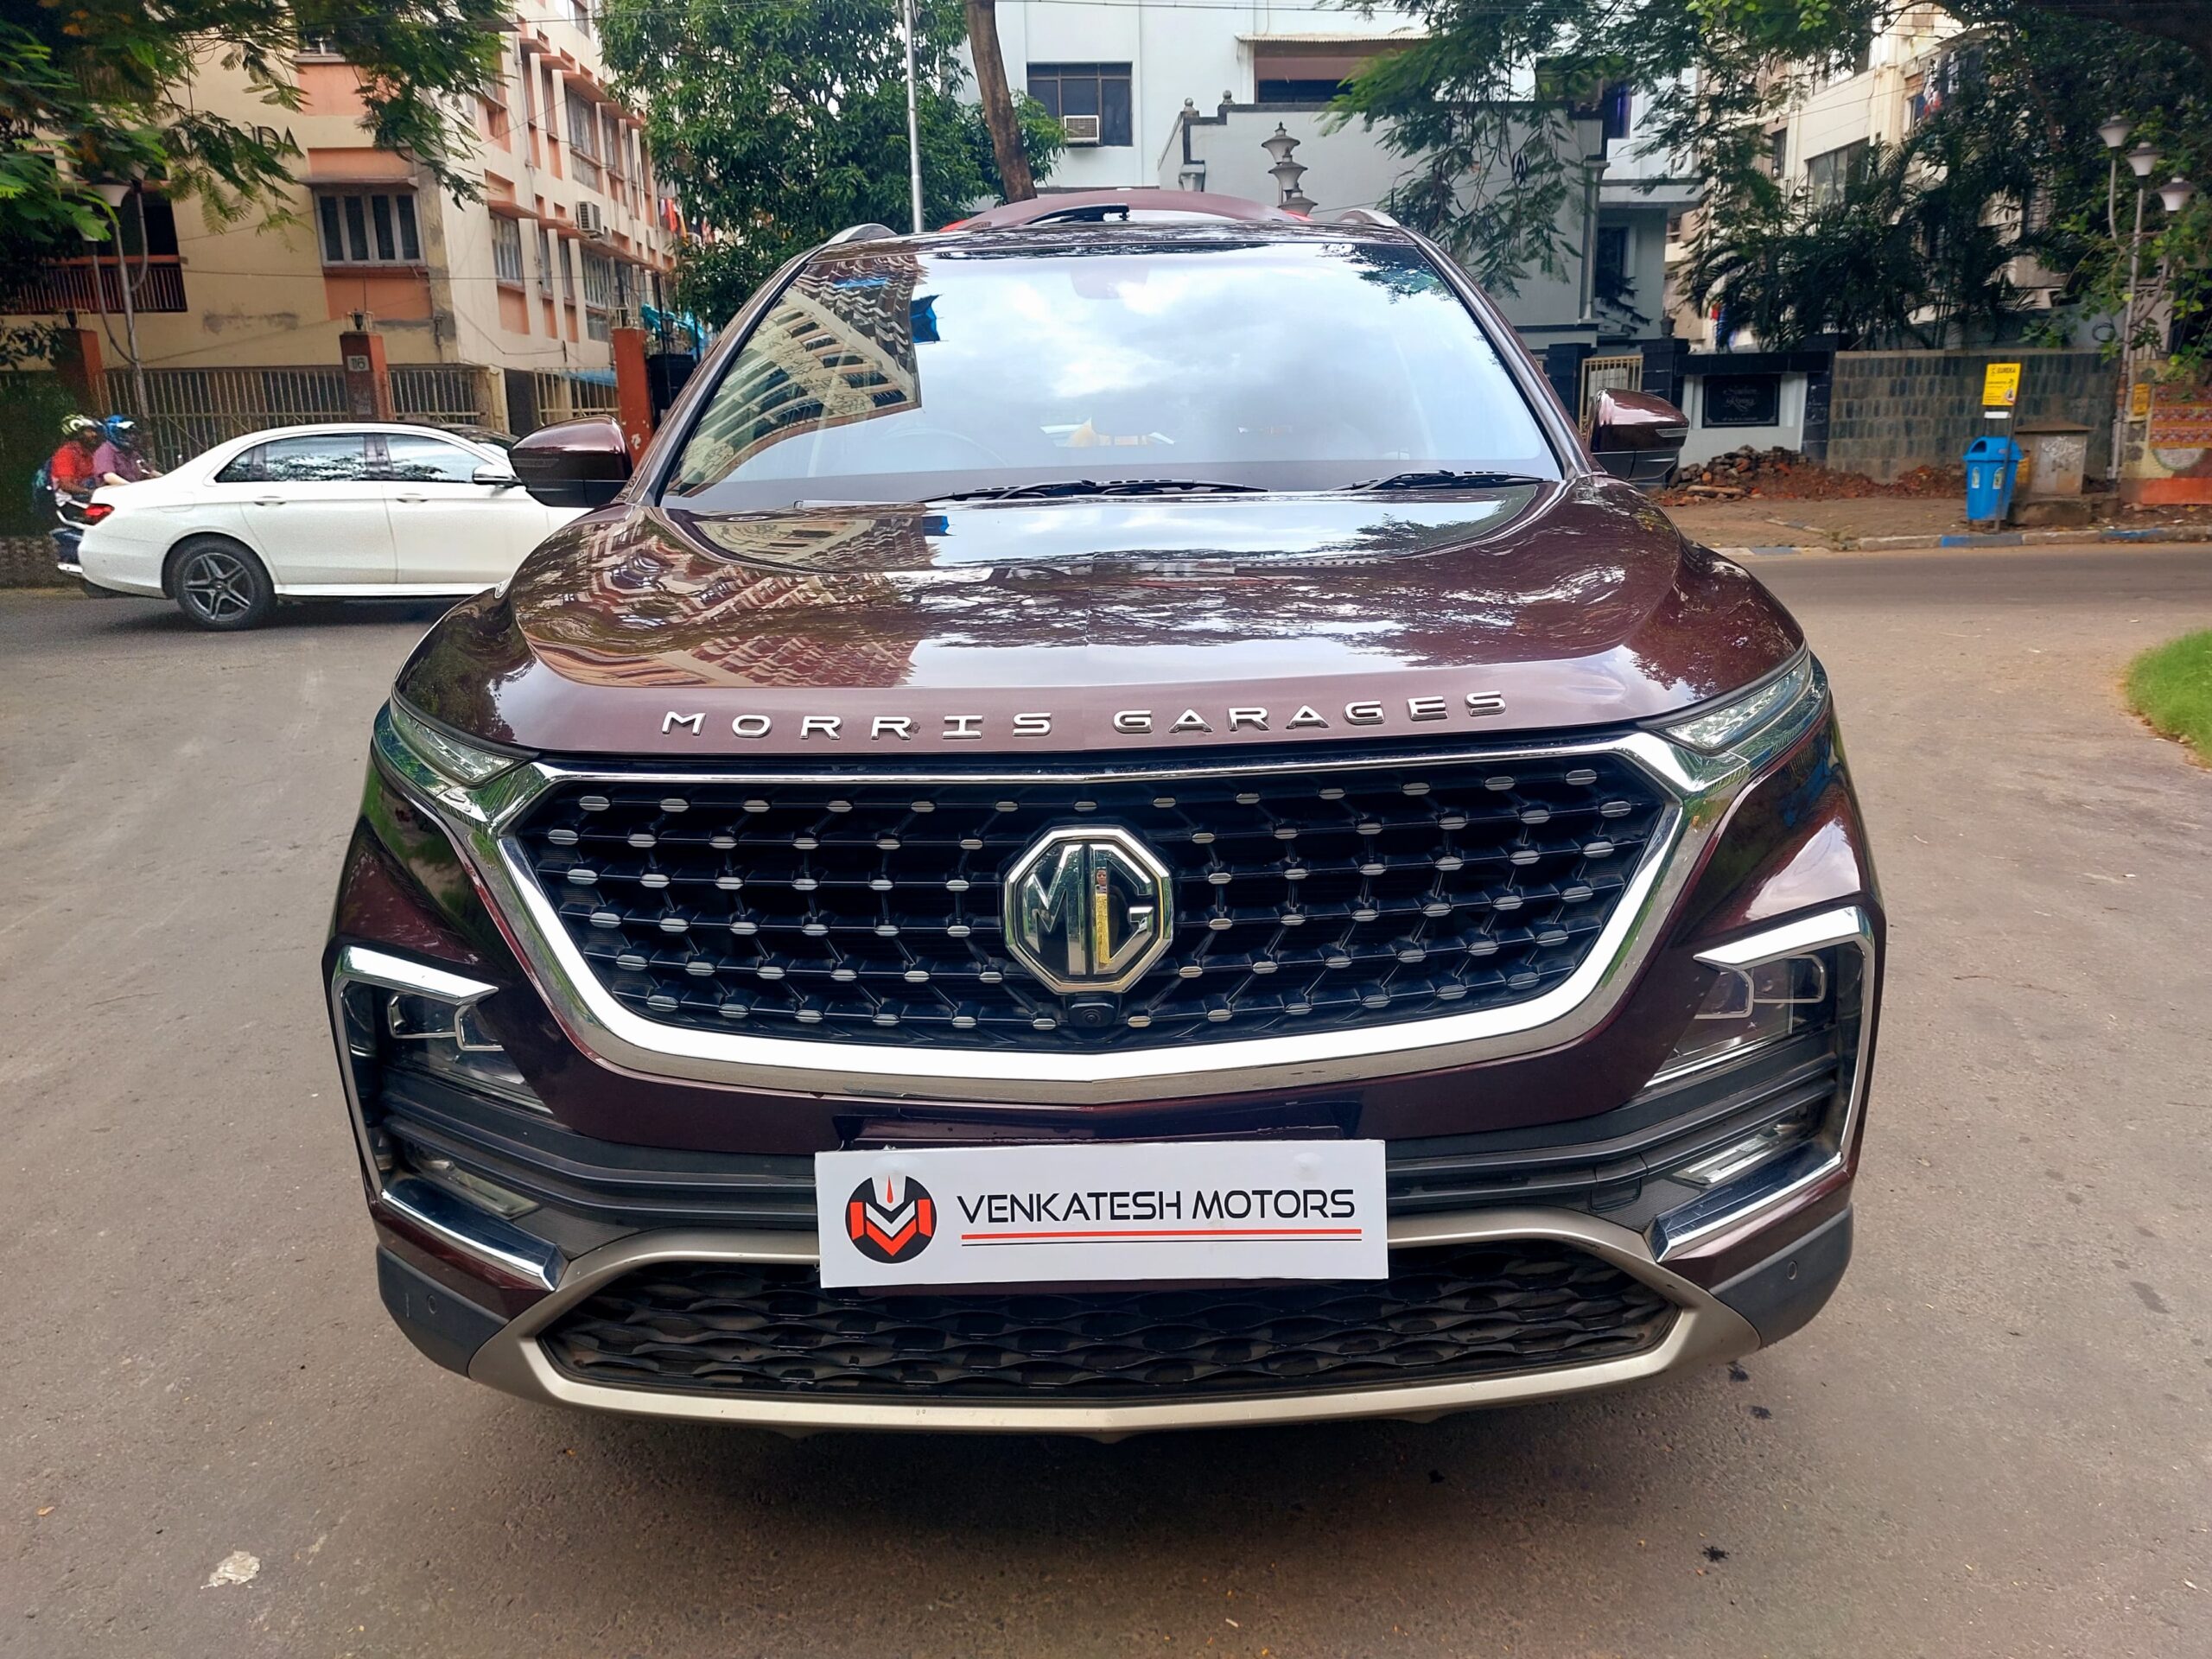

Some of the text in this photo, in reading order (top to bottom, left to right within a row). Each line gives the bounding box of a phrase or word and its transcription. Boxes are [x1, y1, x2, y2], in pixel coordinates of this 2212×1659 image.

[661, 690, 1508, 741] MORRIS GARAGES
[1022, 843, 1154, 976] MG
[957, 1188, 1356, 1224] VENKATESH MOTORS
